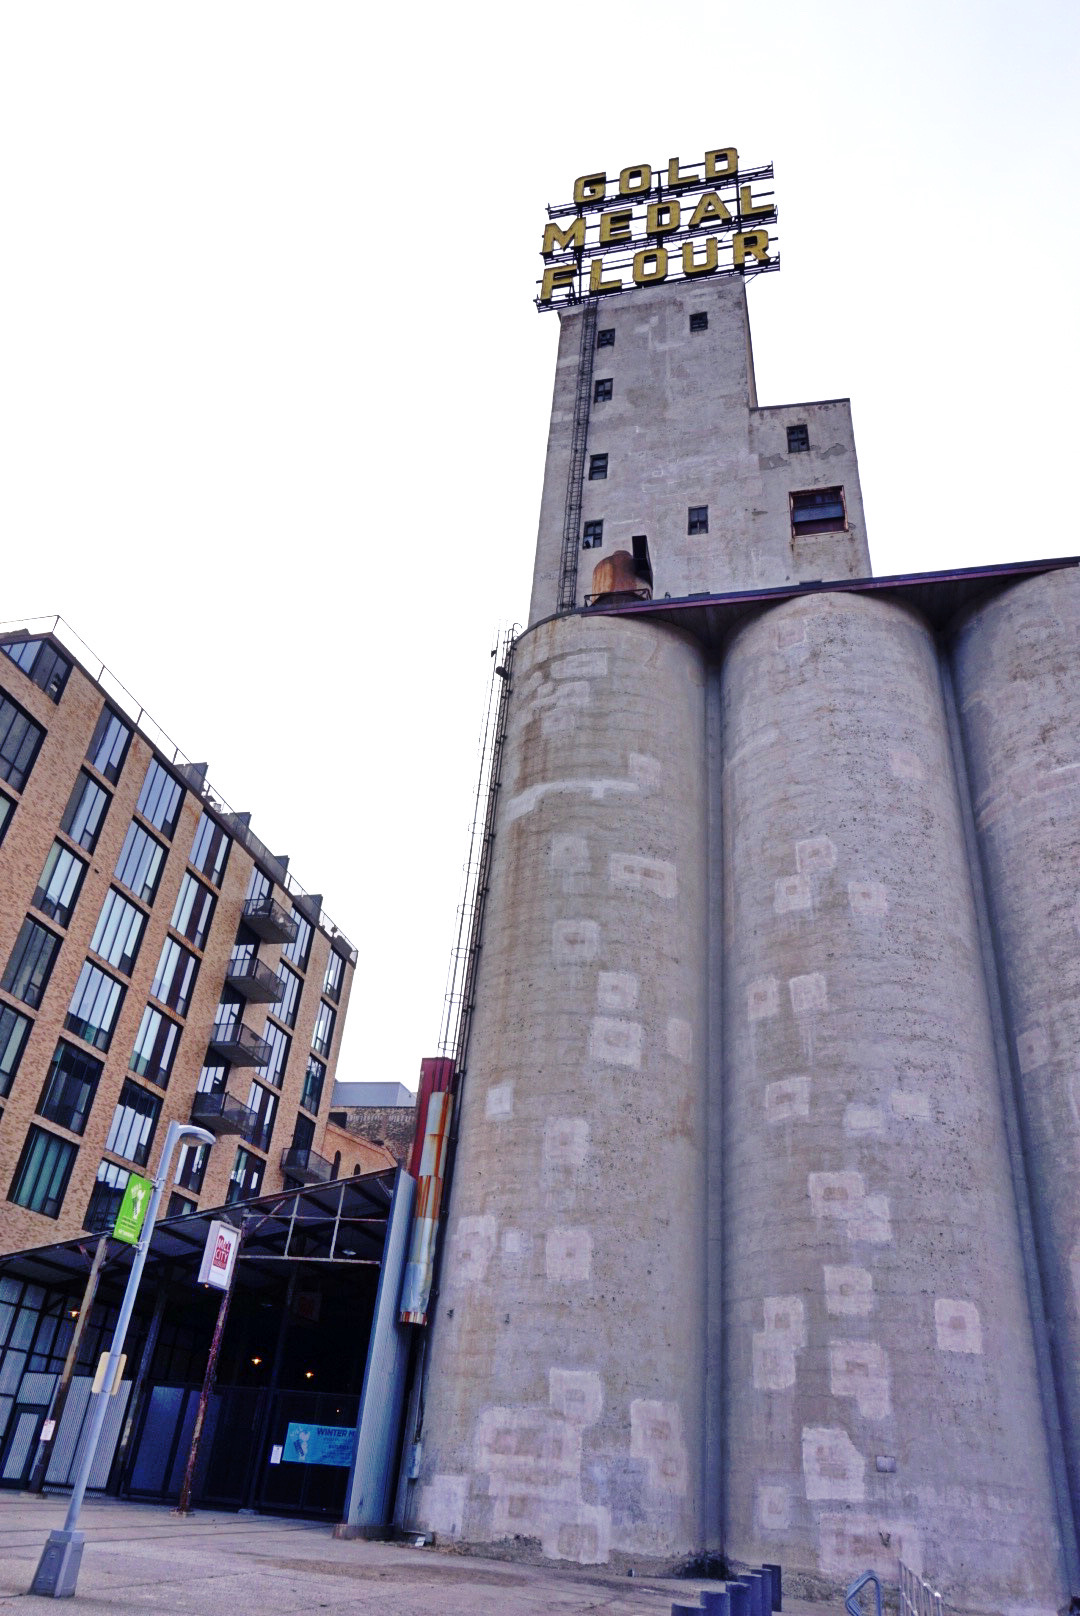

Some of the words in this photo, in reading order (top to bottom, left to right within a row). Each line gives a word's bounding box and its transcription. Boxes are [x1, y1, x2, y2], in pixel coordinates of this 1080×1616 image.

[573, 147, 738, 204] GOLD
[542, 185, 775, 257] MEDAL
[540, 229, 770, 302] FLOUR
[316, 1427, 347, 1437] WINTER
